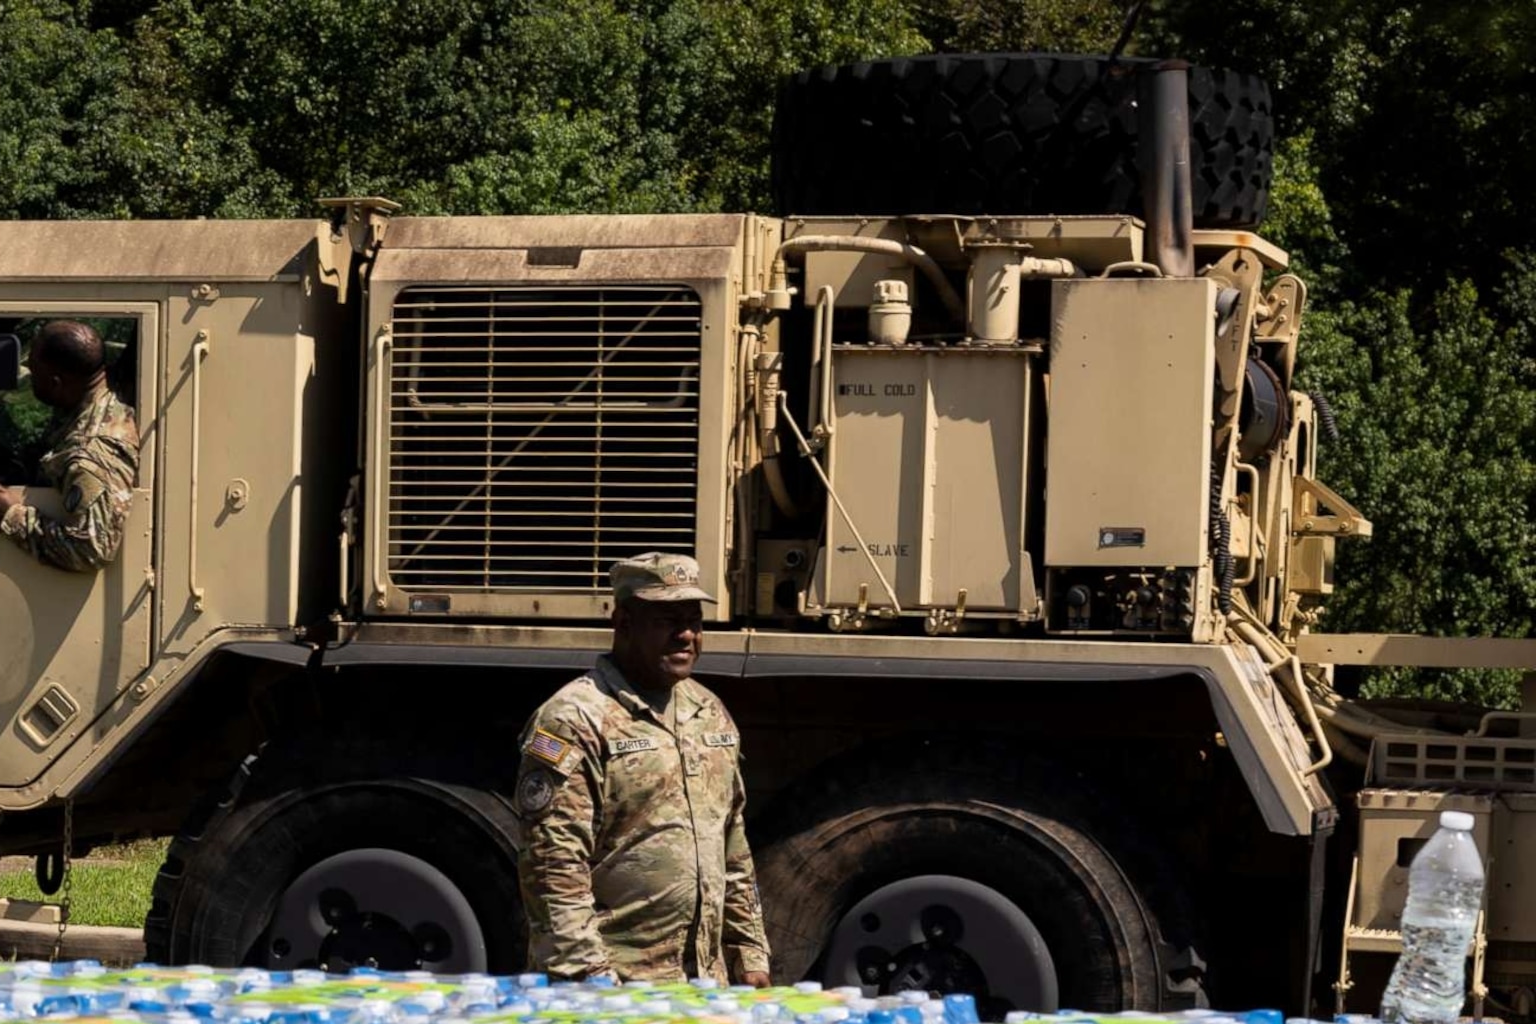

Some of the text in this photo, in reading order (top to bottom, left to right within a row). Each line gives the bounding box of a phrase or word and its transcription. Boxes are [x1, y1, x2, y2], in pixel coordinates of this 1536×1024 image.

[846, 384, 916, 396] FULL COLD
[868, 543, 910, 557] SLAVE
[616, 738, 652, 751] CARTER
